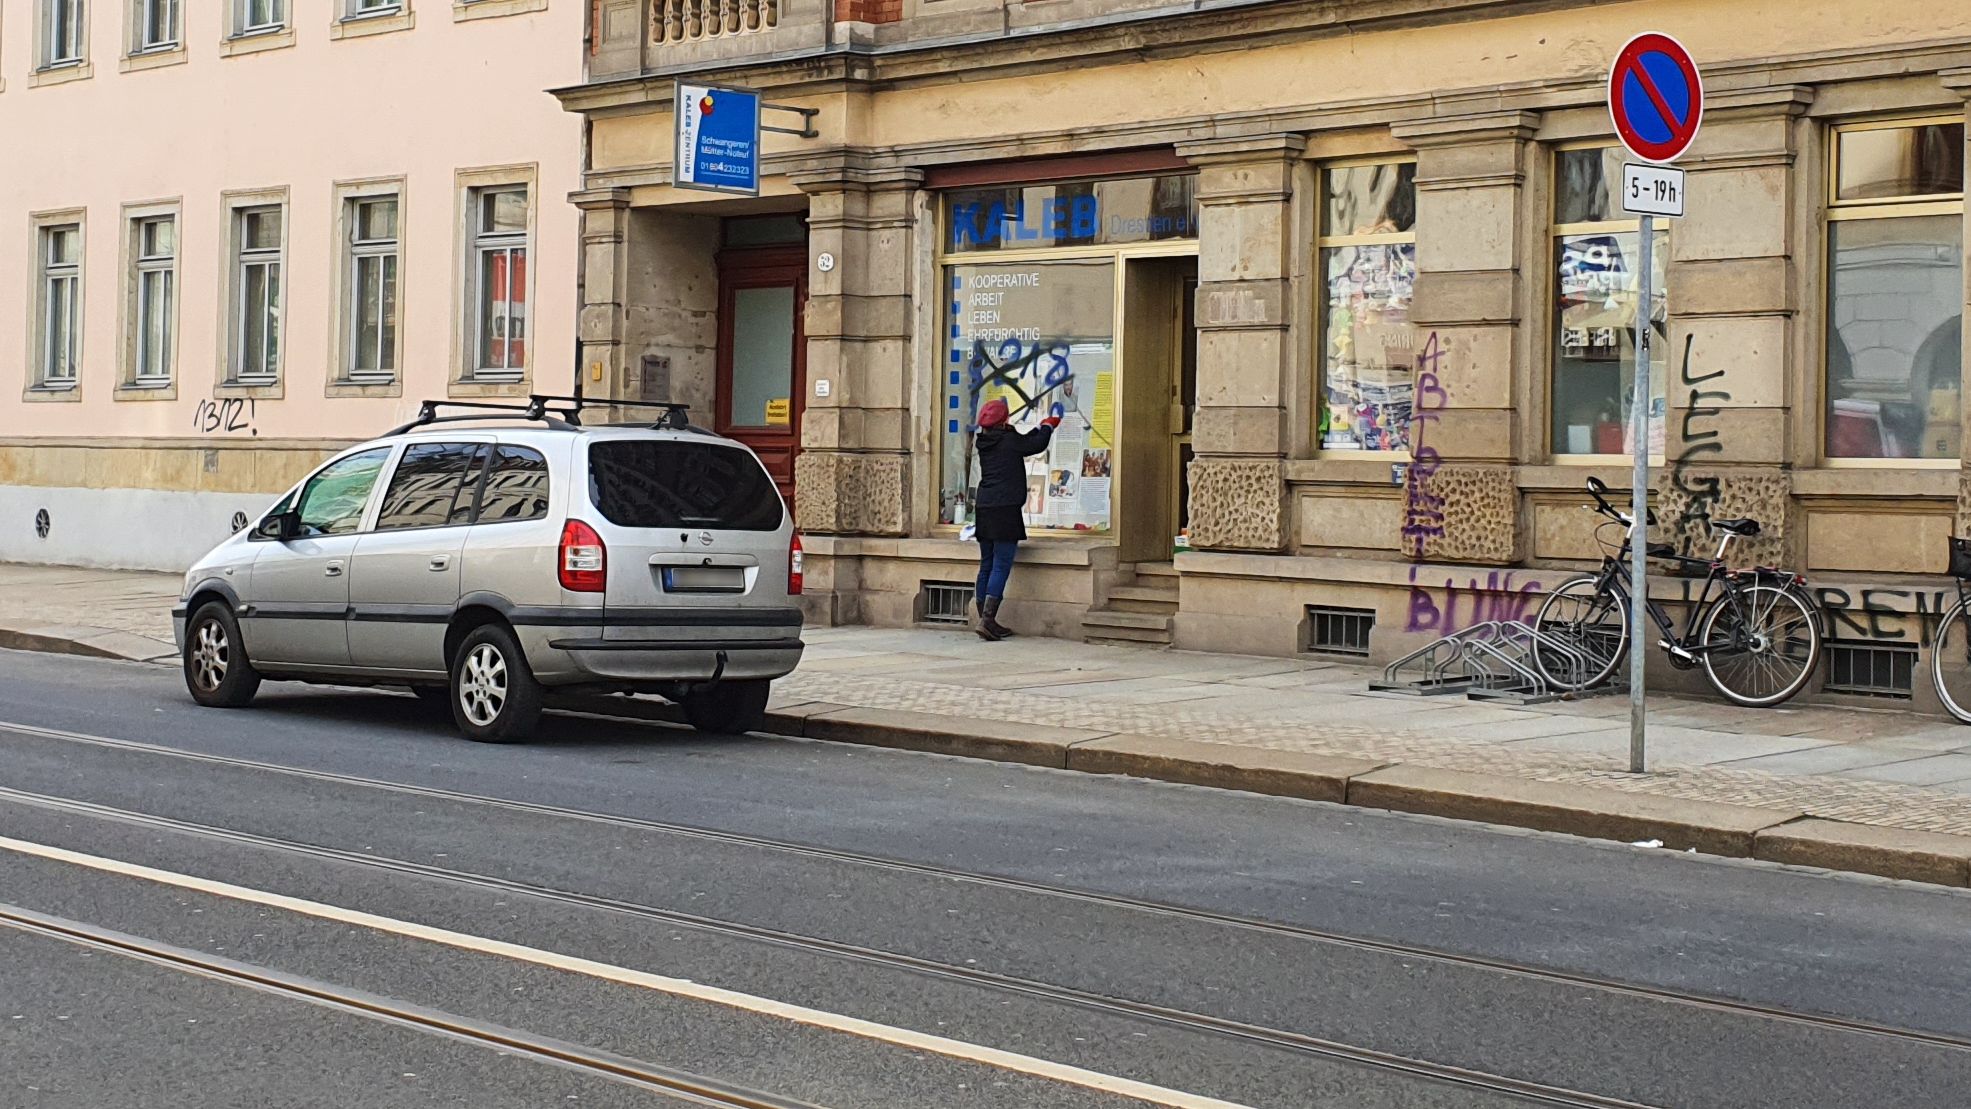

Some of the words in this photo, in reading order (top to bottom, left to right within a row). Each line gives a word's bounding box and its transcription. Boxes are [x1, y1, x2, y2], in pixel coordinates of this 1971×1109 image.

[953, 194, 1100, 245] KALEB
[967, 272, 1040, 290] KOOPERATIVE
[967, 291, 1005, 306] ARBEIT
[967, 309, 1001, 325] LEBEN
